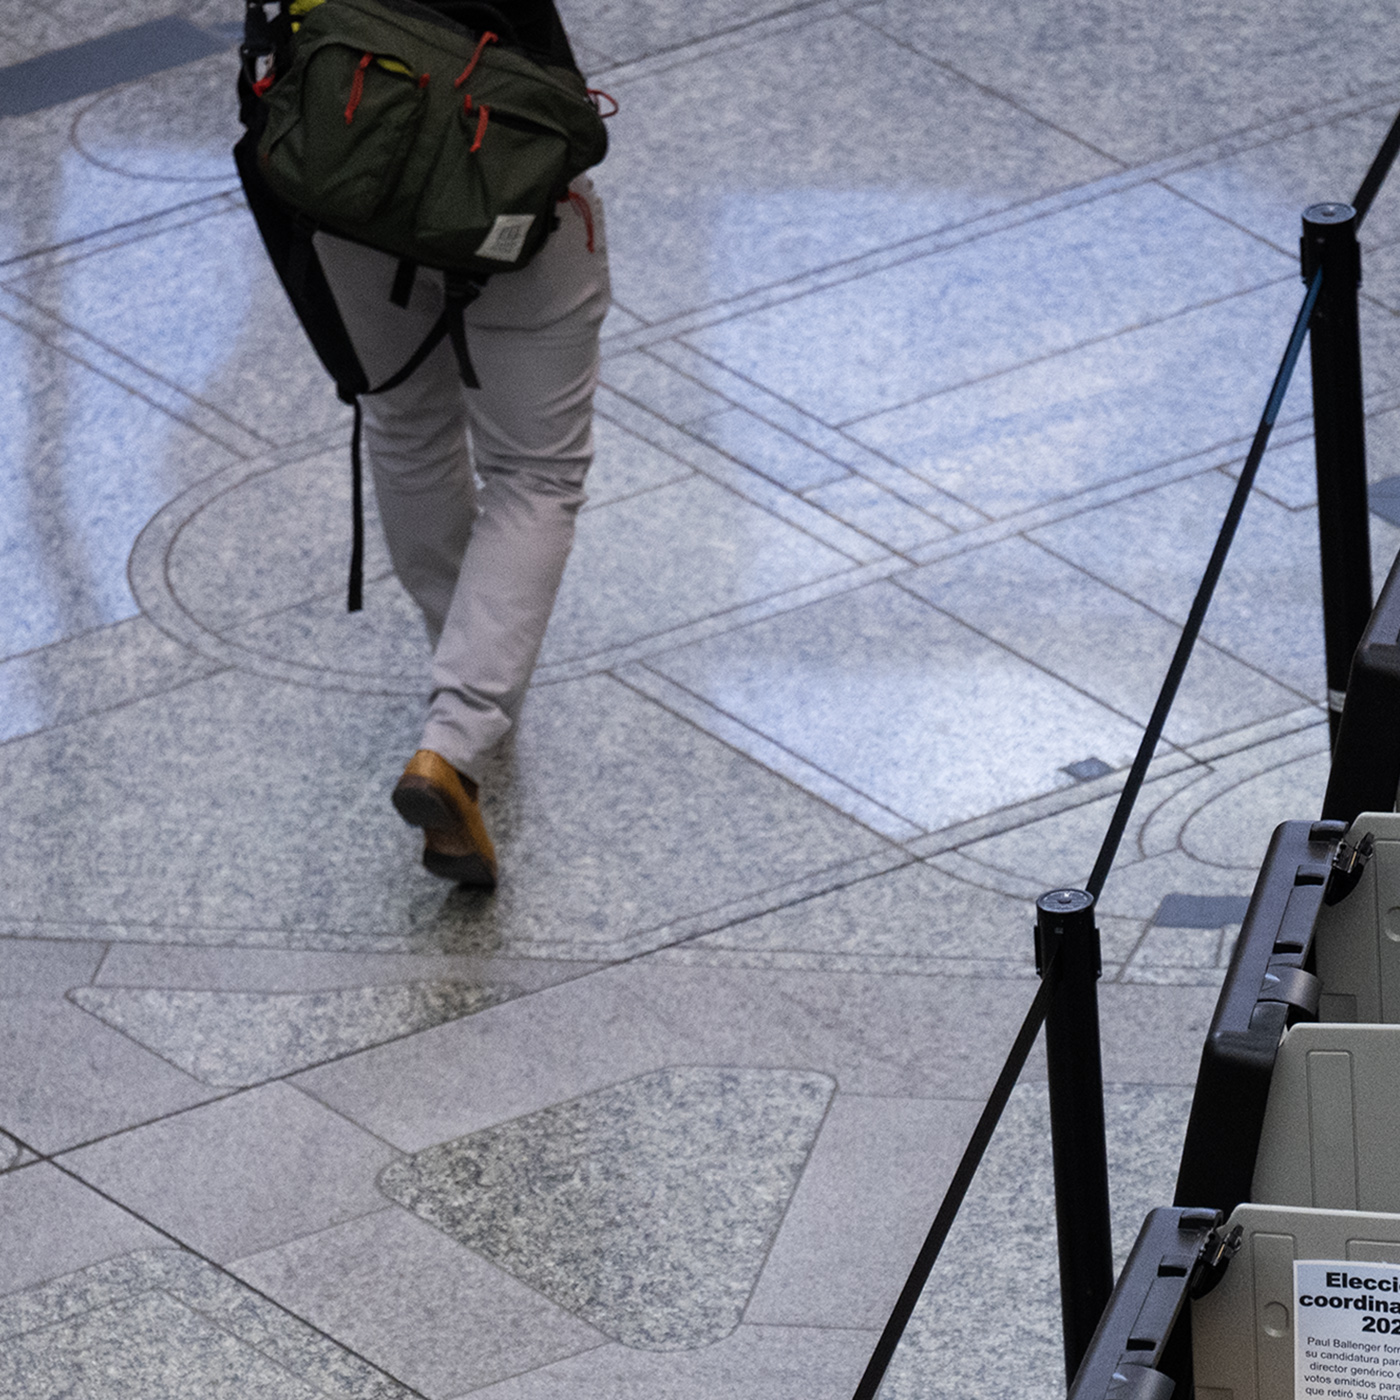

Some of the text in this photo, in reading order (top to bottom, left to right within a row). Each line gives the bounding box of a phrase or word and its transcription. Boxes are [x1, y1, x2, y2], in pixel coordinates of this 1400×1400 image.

[1307, 1336, 1330, 1347] Paul
[1333, 1339, 1381, 1353] Ballenger
[1305, 1350, 1318, 1358] su
[1320, 1352, 1380, 1364] candidatura
[1309, 1362, 1348, 1373] director
[1350, 1367, 1394, 1378] genérico
[1304, 1375, 1332, 1384] votos
[1334, 1378, 1376, 1389] emitidos
[1305, 1387, 1325, 1396] que
[1327, 1389, 1354, 1398] retiró
[1356, 1392, 1368, 1400] su
